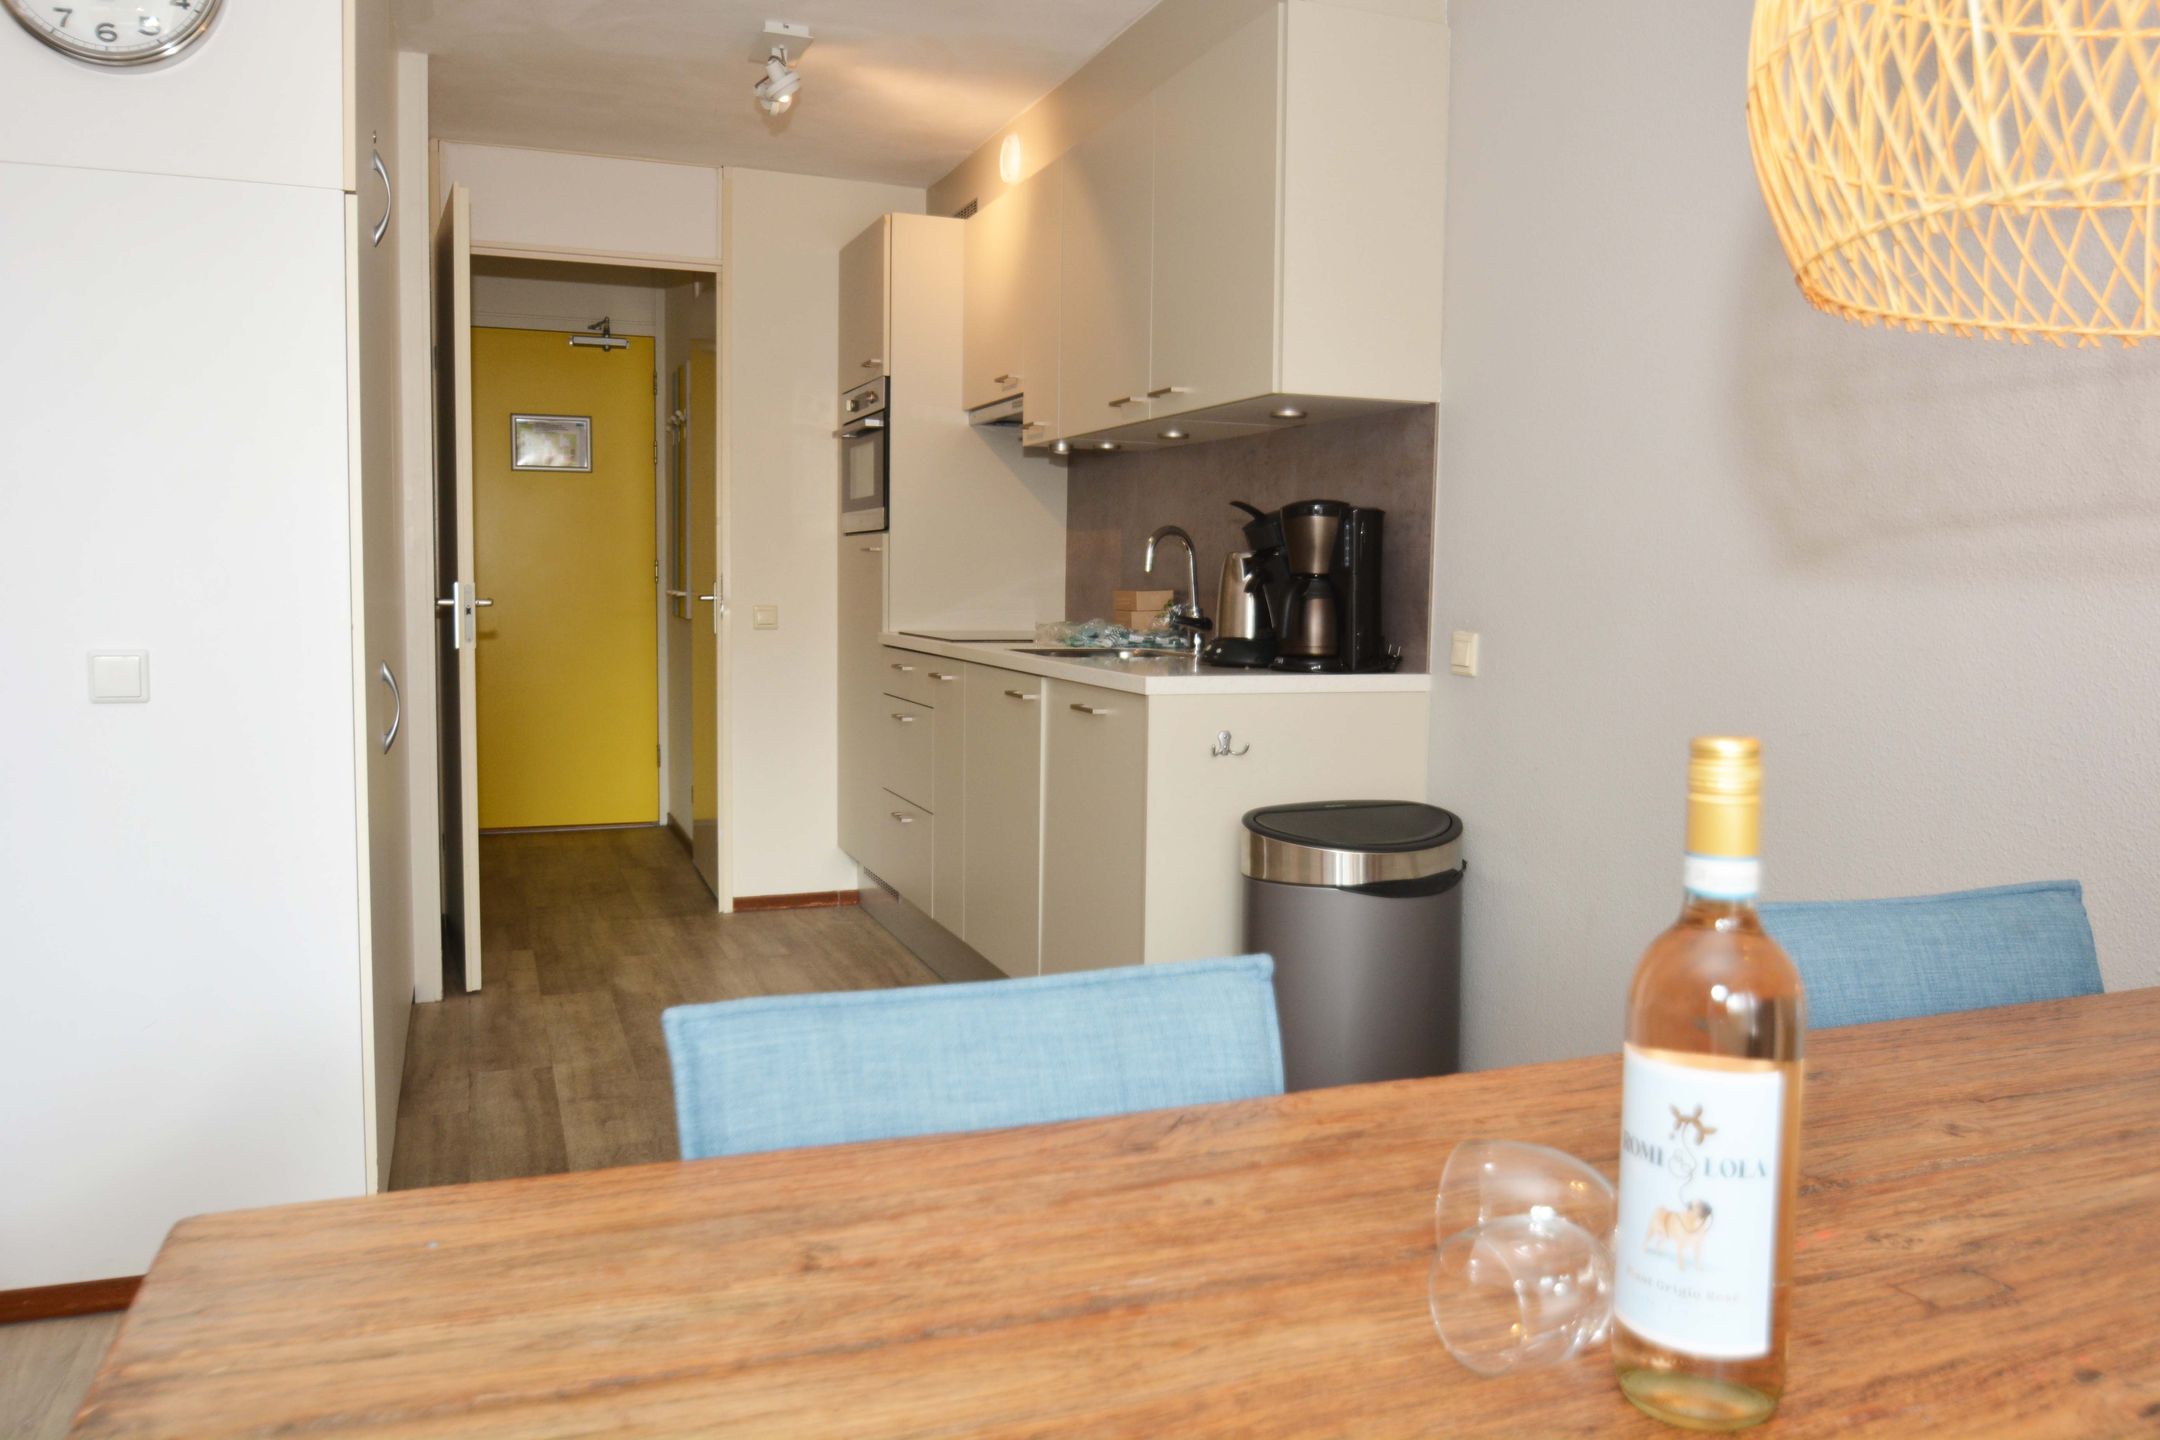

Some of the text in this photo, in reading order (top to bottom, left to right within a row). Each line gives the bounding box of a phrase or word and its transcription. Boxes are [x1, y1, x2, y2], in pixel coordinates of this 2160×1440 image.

[53, 7, 73, 27] 7
[138, 16, 161, 36] 5
[95, 22, 118, 43] 6
[1703, 1157, 1768, 1179] LOLA
